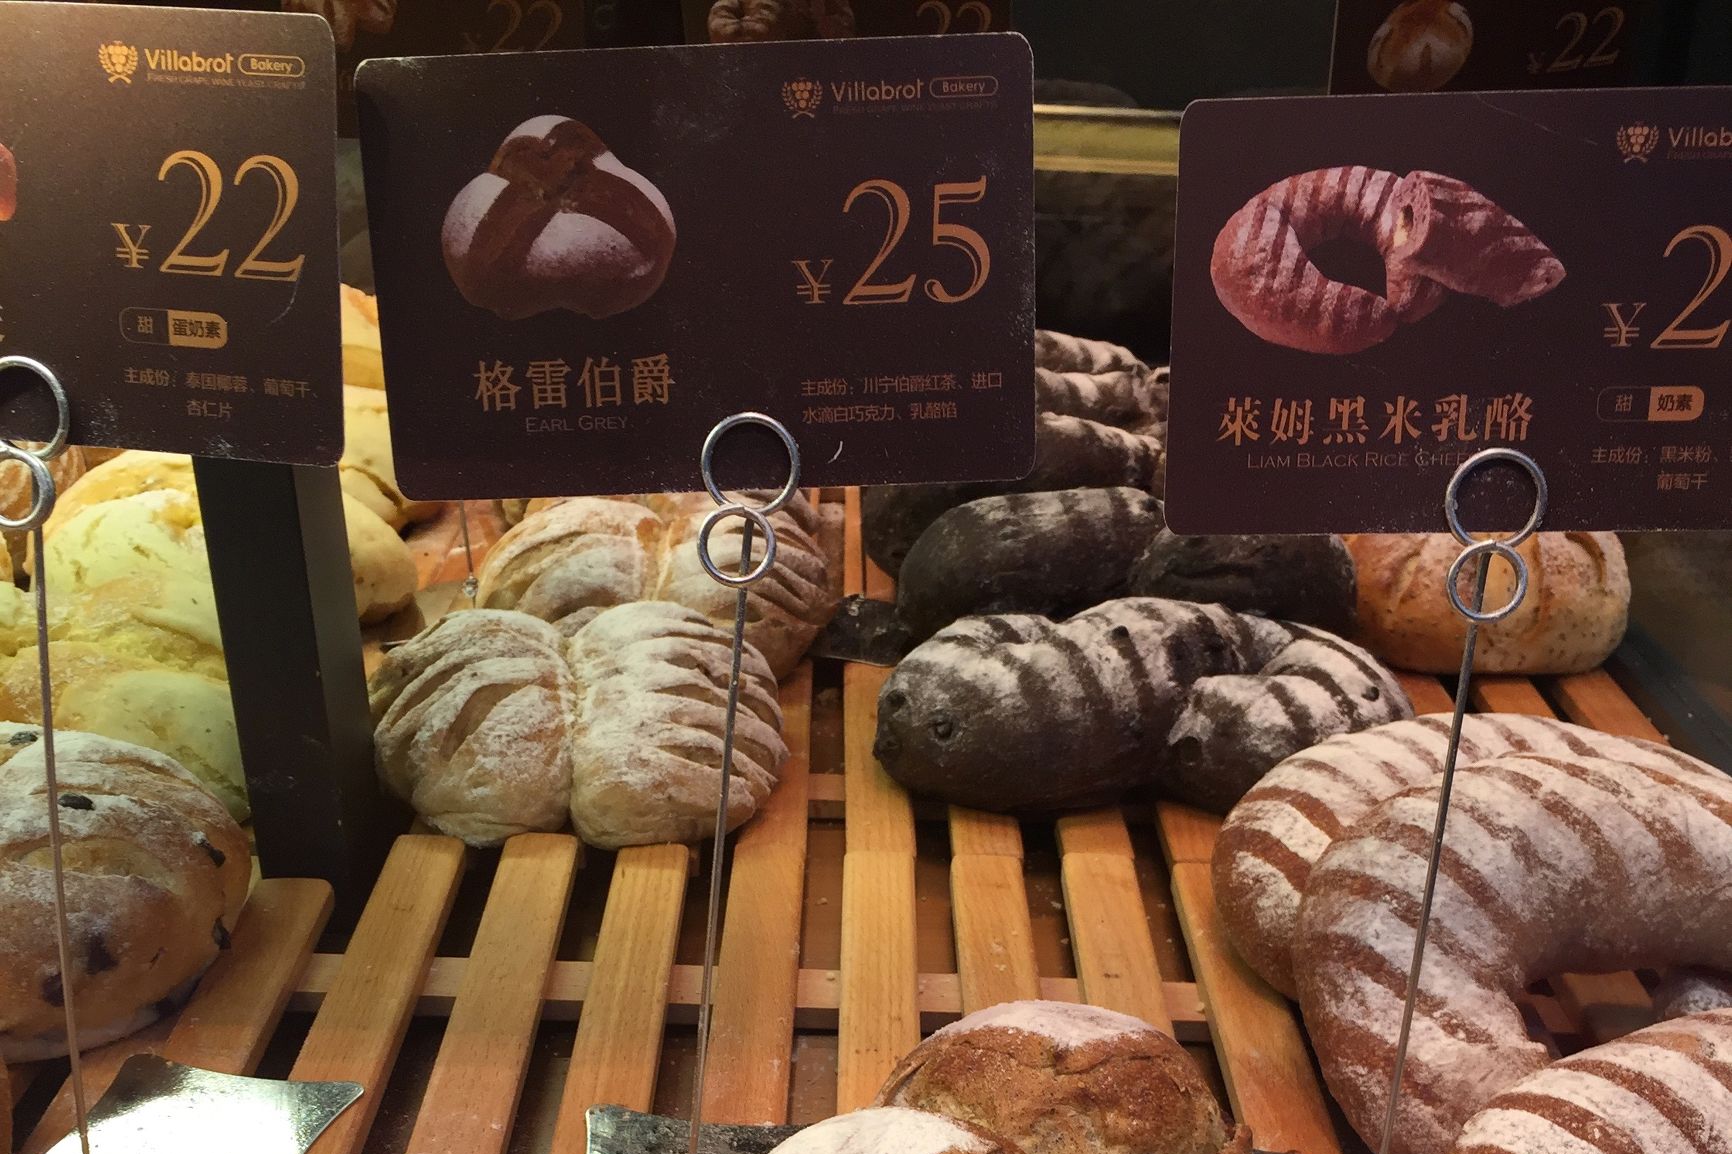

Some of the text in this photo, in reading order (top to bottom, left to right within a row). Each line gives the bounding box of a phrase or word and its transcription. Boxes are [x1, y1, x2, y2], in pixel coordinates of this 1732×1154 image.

[144, 48, 294, 74] Villabrot Bakery
[831, 78, 986, 102] Villabrot Bakery
[137, 315, 221, 339] 甜 蛋奶素
[473, 353, 676, 412] 格雷伯爵
[187, 400, 232, 419] 杏仁片
[1615, 394, 1693, 412] 甜 奶素
[526, 415, 628, 432] EARL GREY
[1215, 392, 1534, 446] 萊姆黑米乳酪
[1247, 451, 1474, 469] LIAM BLACK RICE CHEE
